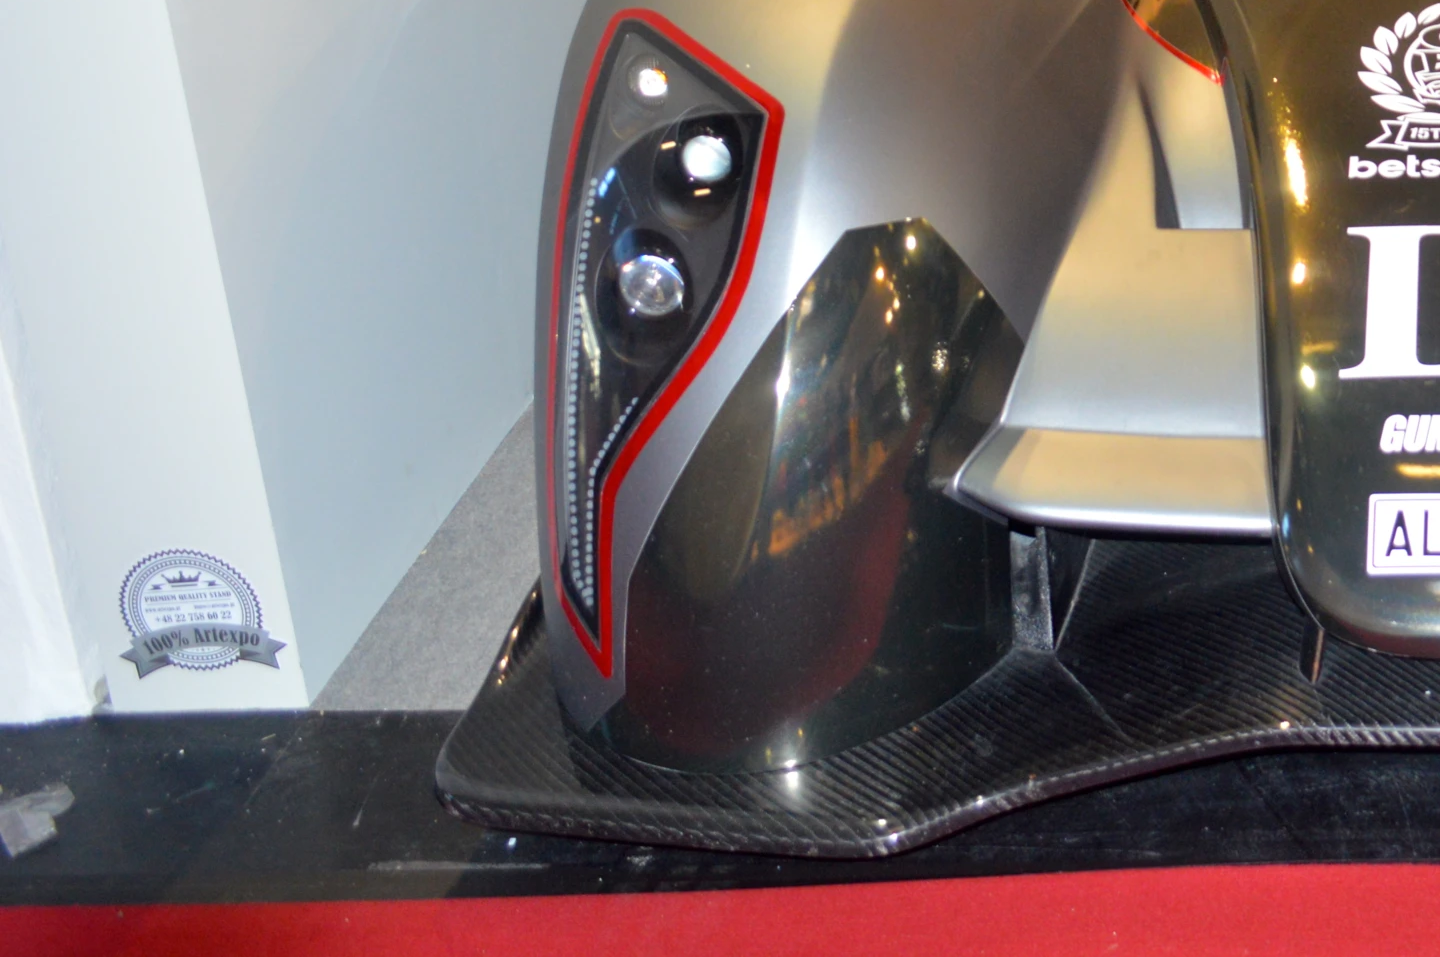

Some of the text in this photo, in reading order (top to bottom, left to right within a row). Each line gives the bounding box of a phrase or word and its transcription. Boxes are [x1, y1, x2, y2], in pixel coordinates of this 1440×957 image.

[144, 590, 232, 603] PREMIUM QUALITY STAND
[142, 627, 261, 655] 100% Artexpo
